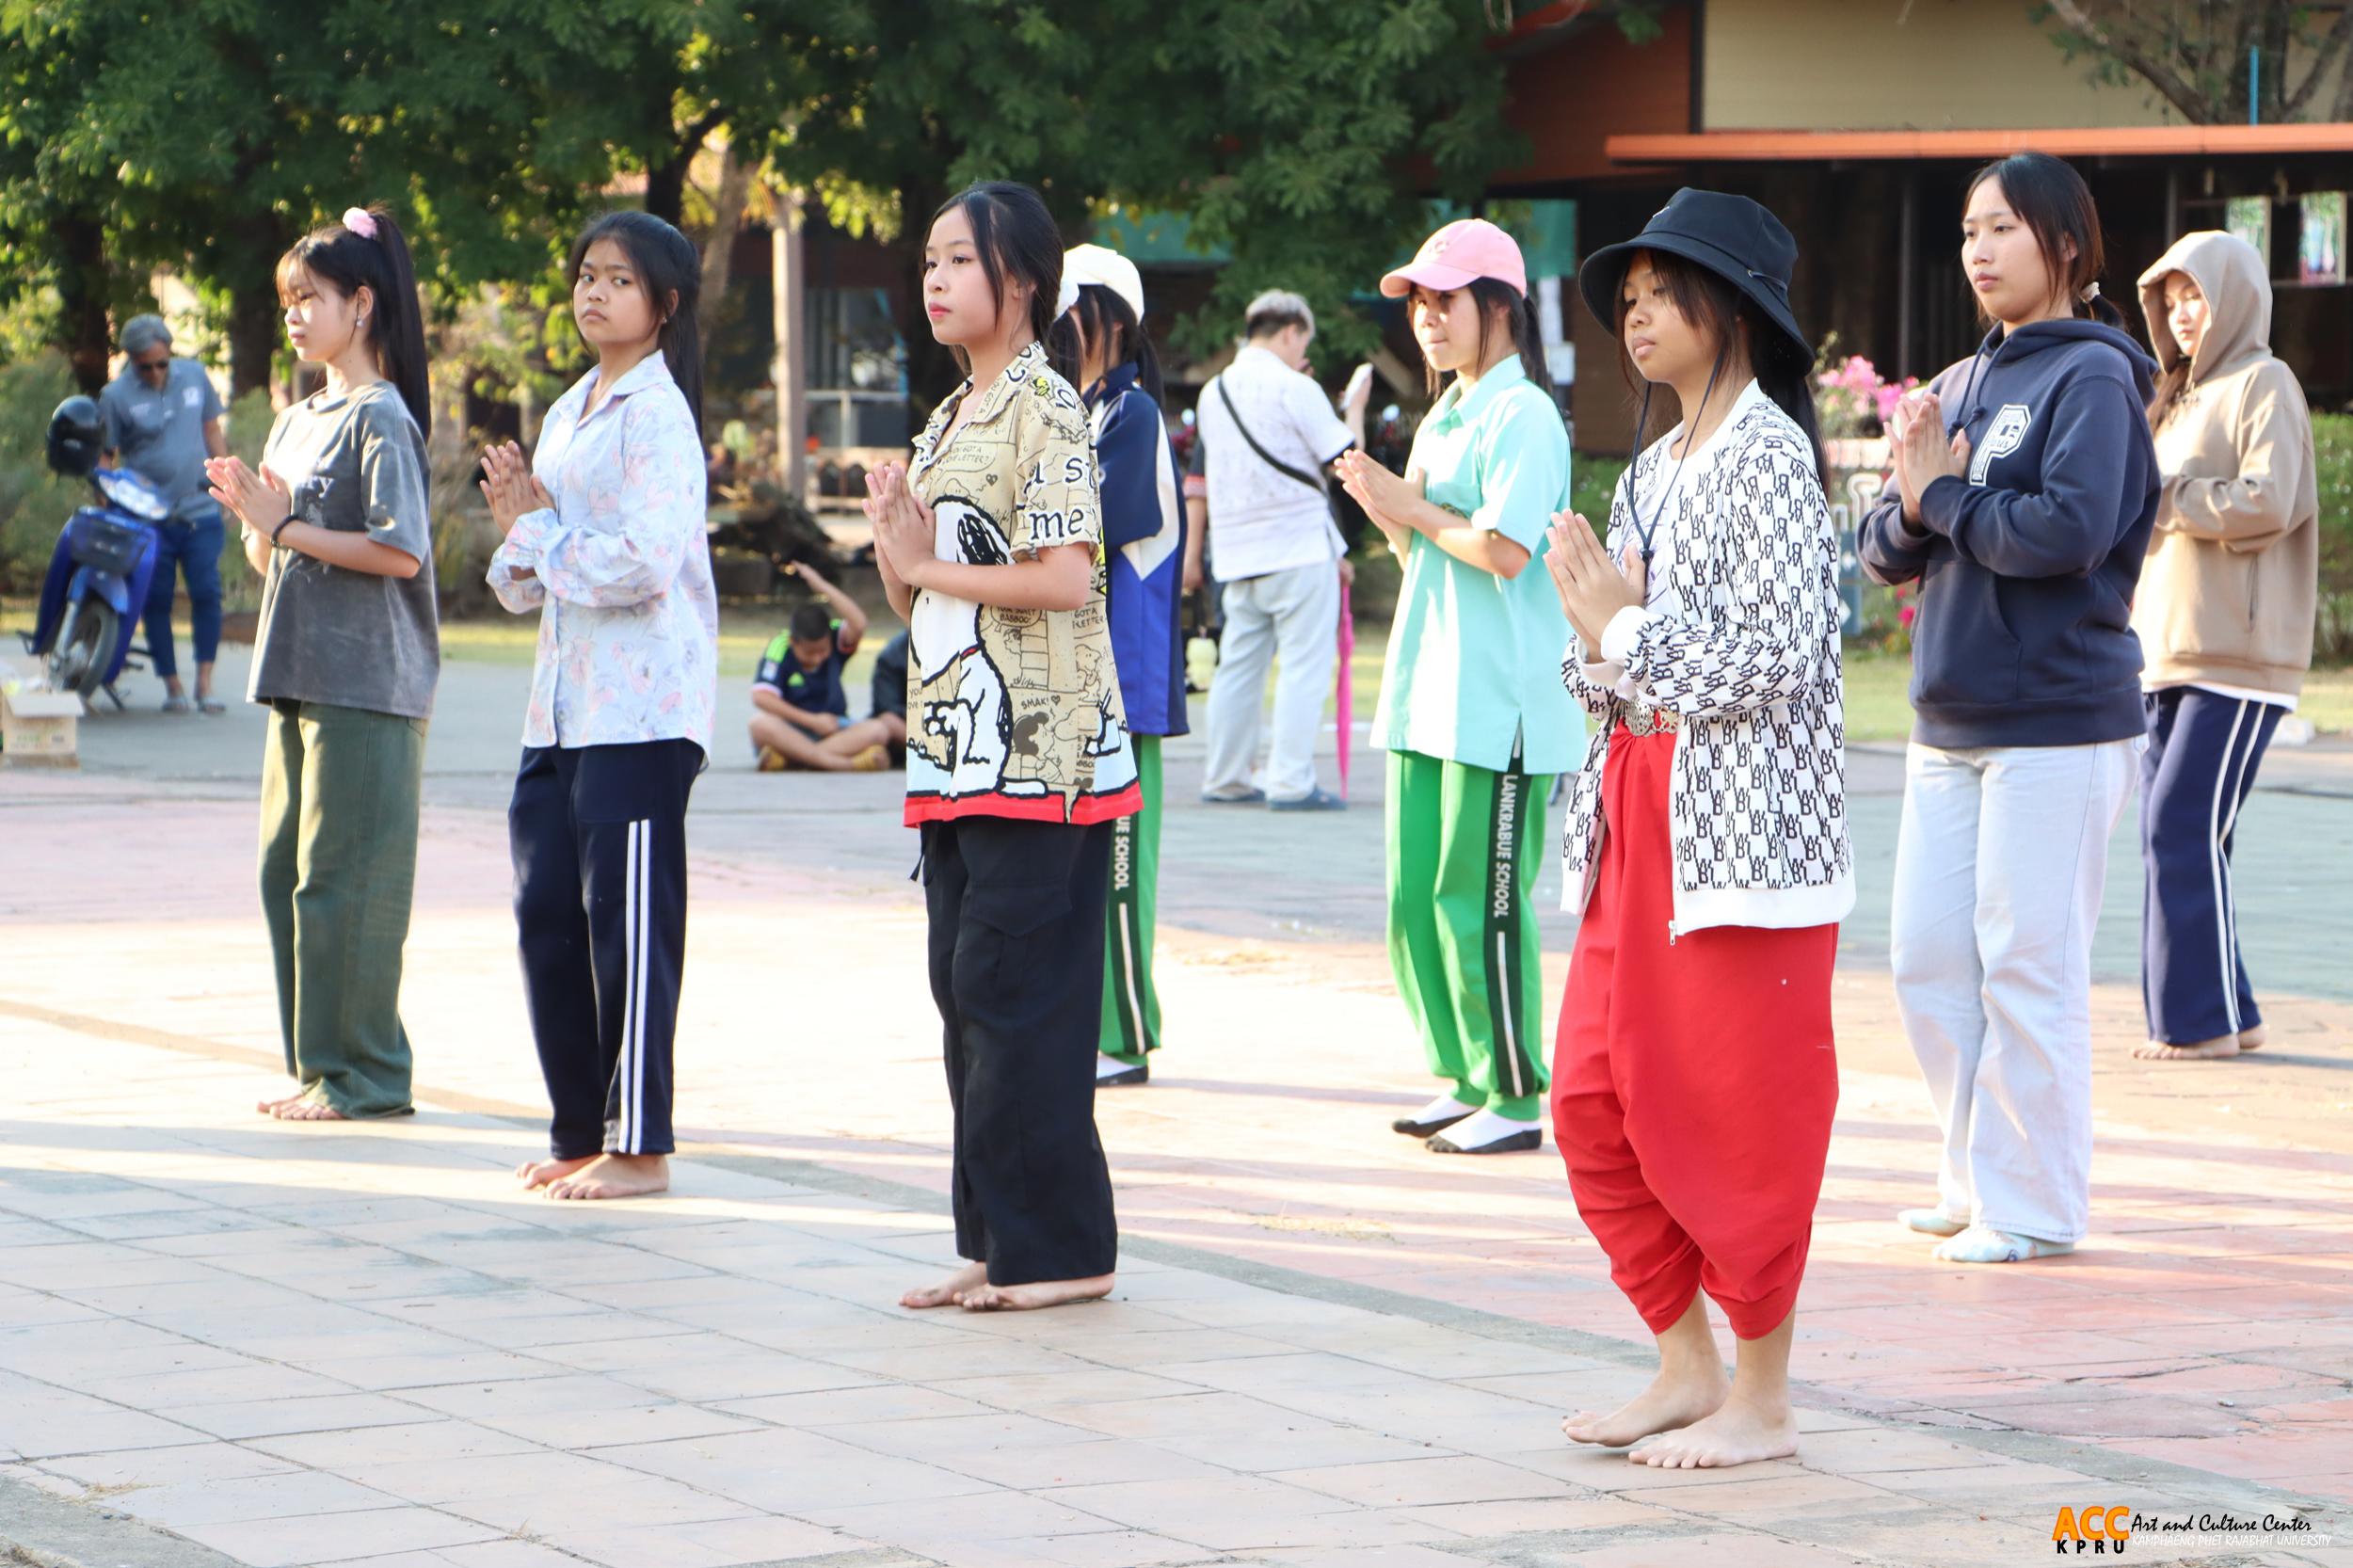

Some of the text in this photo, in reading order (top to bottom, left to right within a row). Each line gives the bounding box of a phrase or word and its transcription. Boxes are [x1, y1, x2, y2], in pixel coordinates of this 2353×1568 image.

[1969, 404, 2032, 487] P
[1029, 509, 1084, 540] me
[1113, 835, 1130, 891] SCHOOL
[1493, 774, 1519, 919] LANKRABUE SCHOOL
